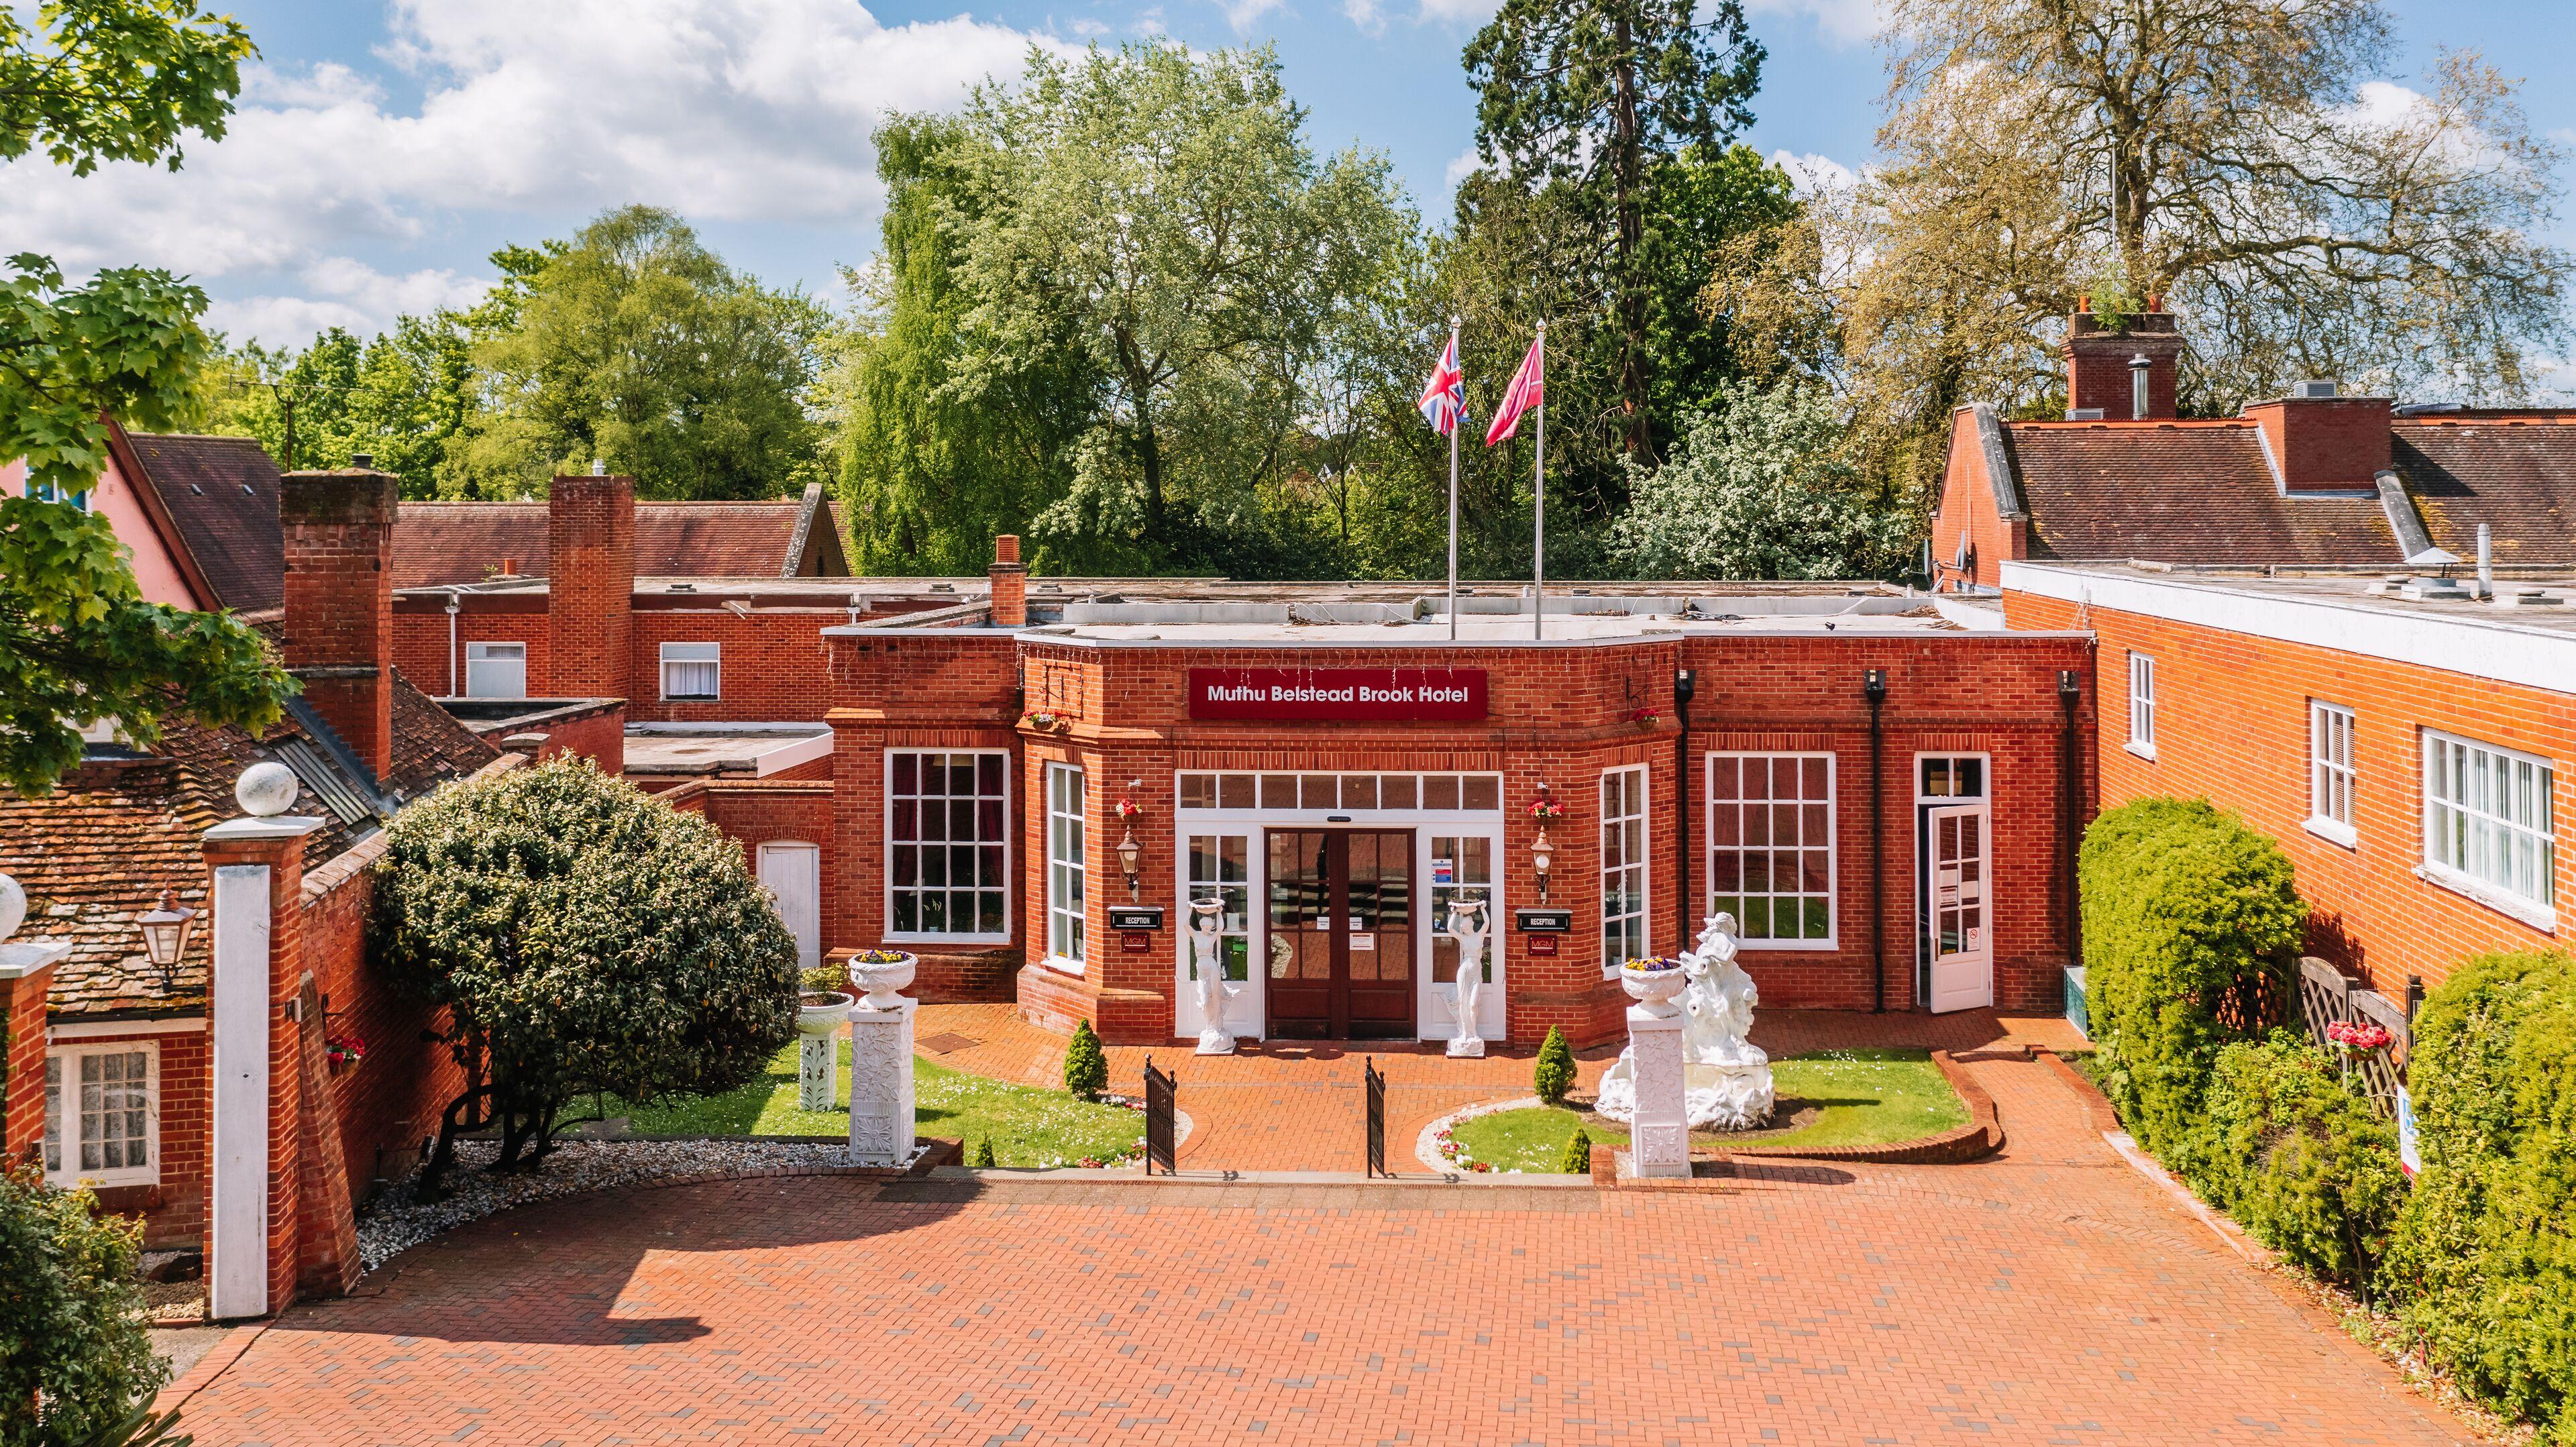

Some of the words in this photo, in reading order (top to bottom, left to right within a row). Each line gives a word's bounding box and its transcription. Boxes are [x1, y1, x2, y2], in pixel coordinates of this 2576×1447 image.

[1207, 685, 1266, 702] Muthu
[1271, 686, 1354, 702] Belstead
[1359, 686, 1413, 702] Brook
[1419, 686, 1468, 702] Hotel
[1125, 916, 1150, 924] RECEPTION
[1530, 918, 1556, 926] RECEPTION
[1124, 937, 1146, 945] MGM
